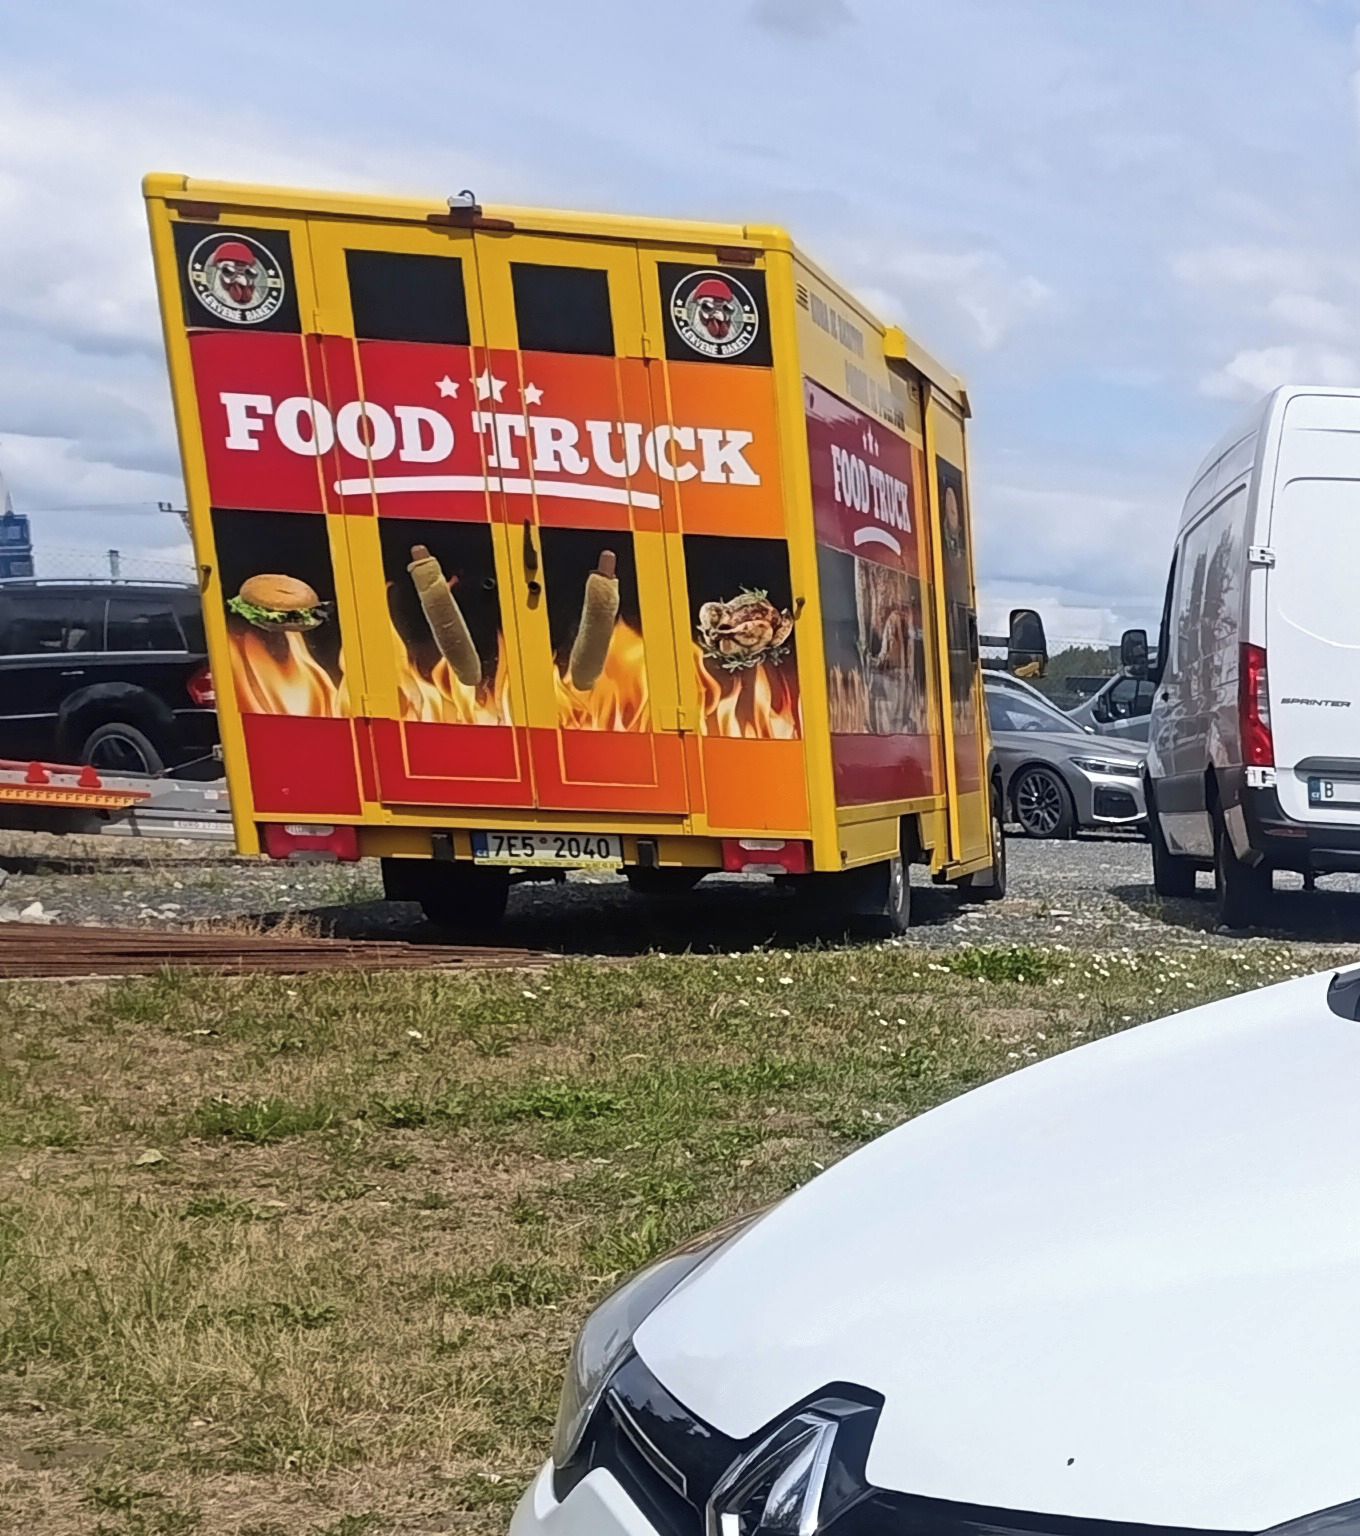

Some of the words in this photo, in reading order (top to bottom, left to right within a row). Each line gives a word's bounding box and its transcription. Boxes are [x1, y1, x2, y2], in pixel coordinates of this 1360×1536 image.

[219, 392, 455, 463] FOOD
[471, 410, 761, 486] TRUCK
[830, 443, 870, 514] FOOD
[869, 464, 912, 534] TRUCK
[1280, 697, 1351, 708] SPRINTER
[1324, 781, 1334, 798] B
[491, 836, 535, 857] 7E5
[553, 837, 610, 859] 2040
